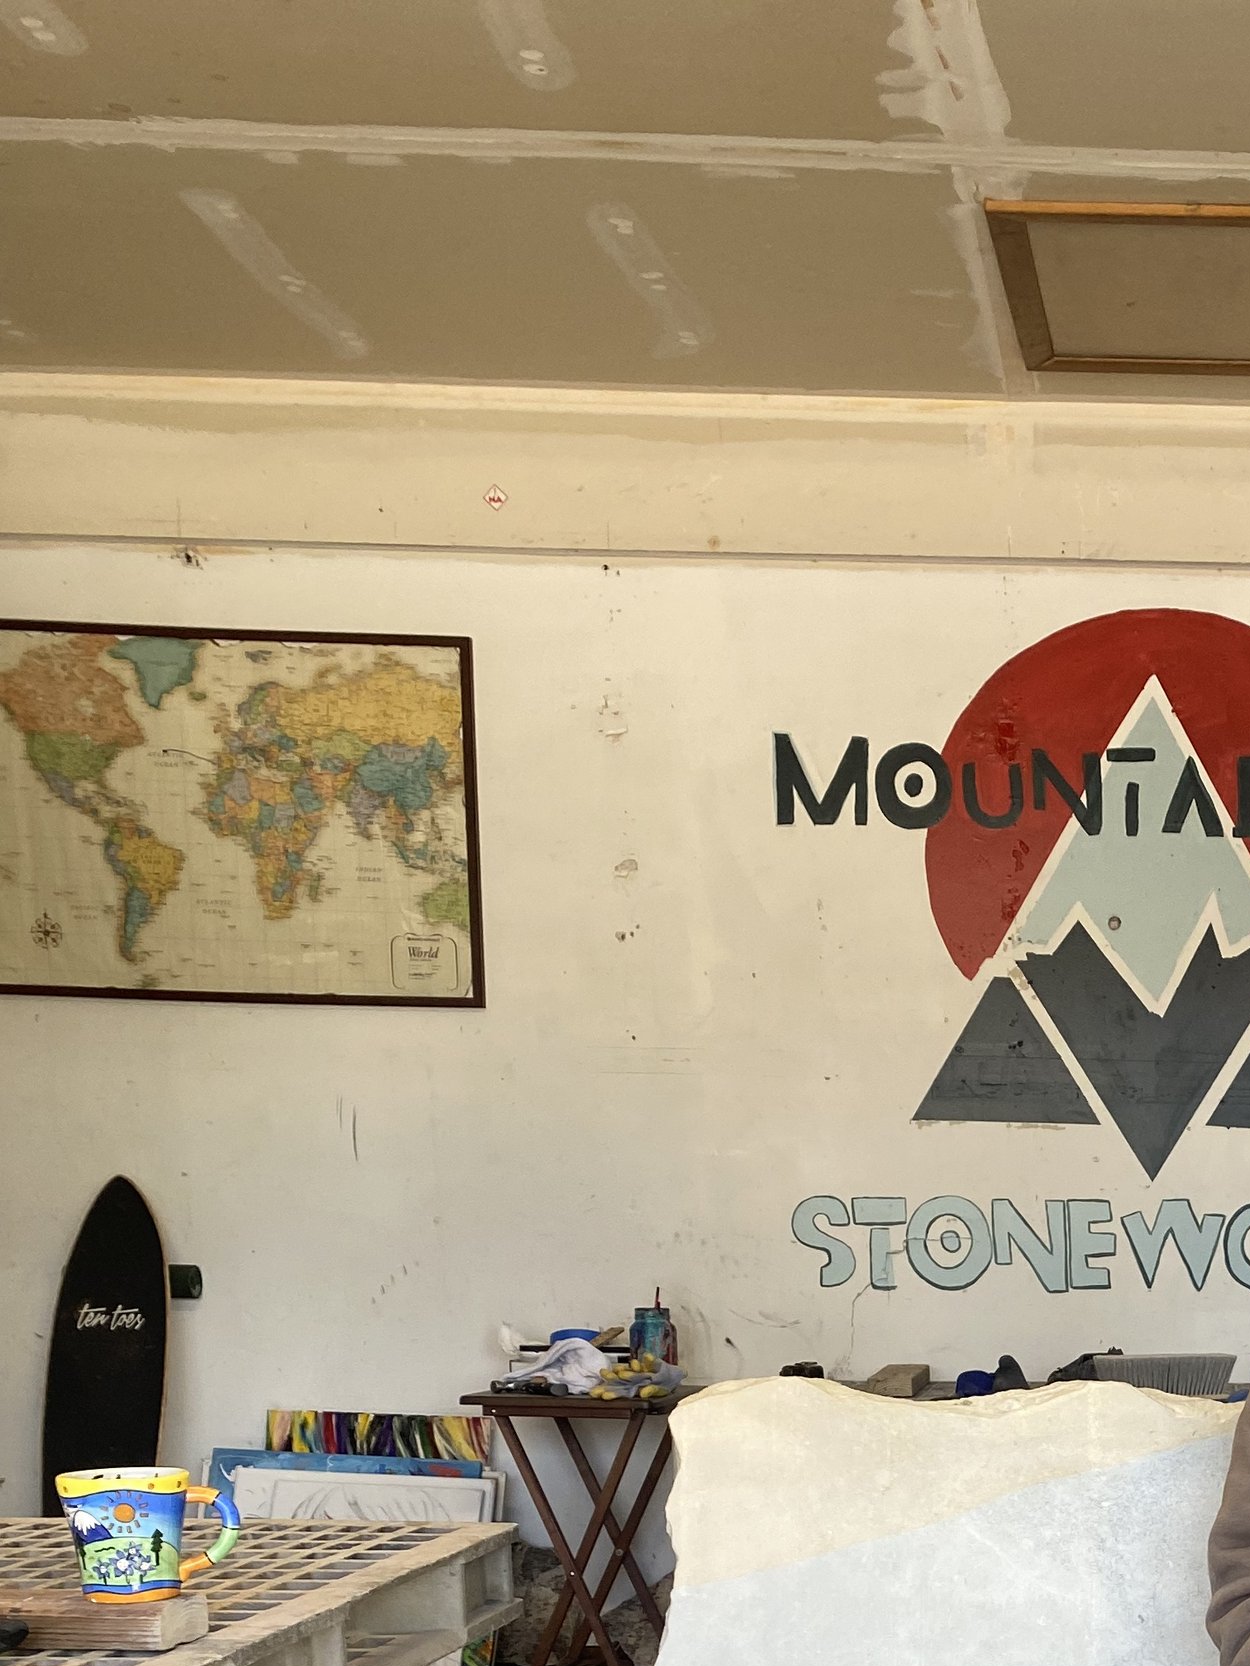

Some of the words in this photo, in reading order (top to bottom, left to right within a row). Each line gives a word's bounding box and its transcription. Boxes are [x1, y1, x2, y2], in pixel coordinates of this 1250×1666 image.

[408, 946, 440, 959] World
[77, 1303, 110, 1330] ten
[110, 1304, 146, 1331] toes
